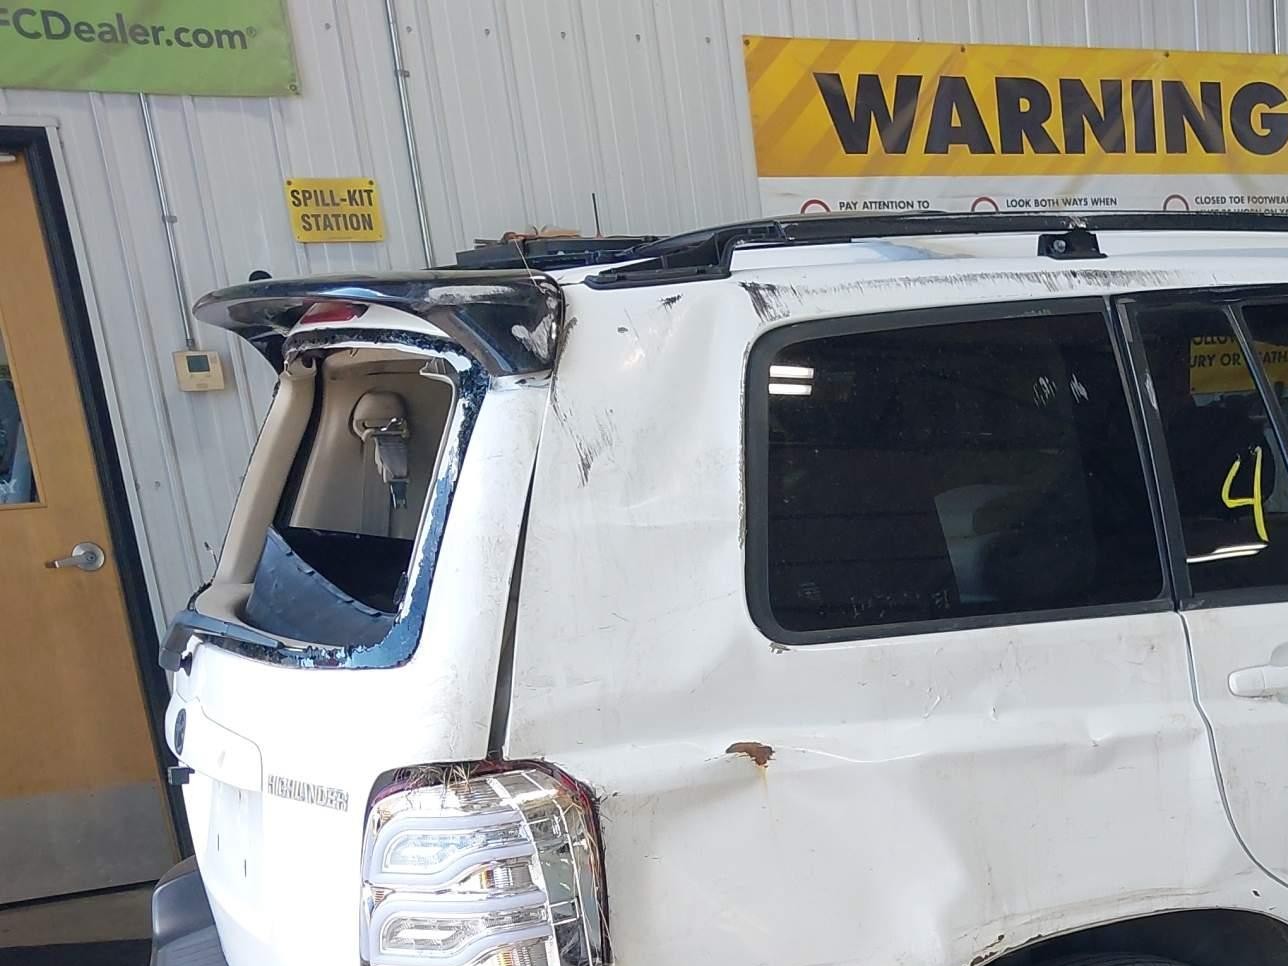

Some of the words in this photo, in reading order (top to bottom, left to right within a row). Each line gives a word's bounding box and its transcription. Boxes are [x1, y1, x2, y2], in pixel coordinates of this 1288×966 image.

[290, 189, 374, 207] SPILL-KIT
[1006, 198, 1032, 208] LOOK
[1033, 198, 1058, 208] BOTH
[1061, 197, 1088, 207] WAYS
[1090, 196, 1117, 207] WHEN
[1194, 196, 1226, 205] CLOSED
[1229, 196, 1245, 205] TOE
[839, 201, 858, 211] PAY
[862, 200, 914, 210] ATTENTION
[917, 200, 930, 209] TO
[301, 213, 374, 232] STATION
[1220, 353, 1241, 366] OR
[267, 775, 349, 812] HIGHLANDER
